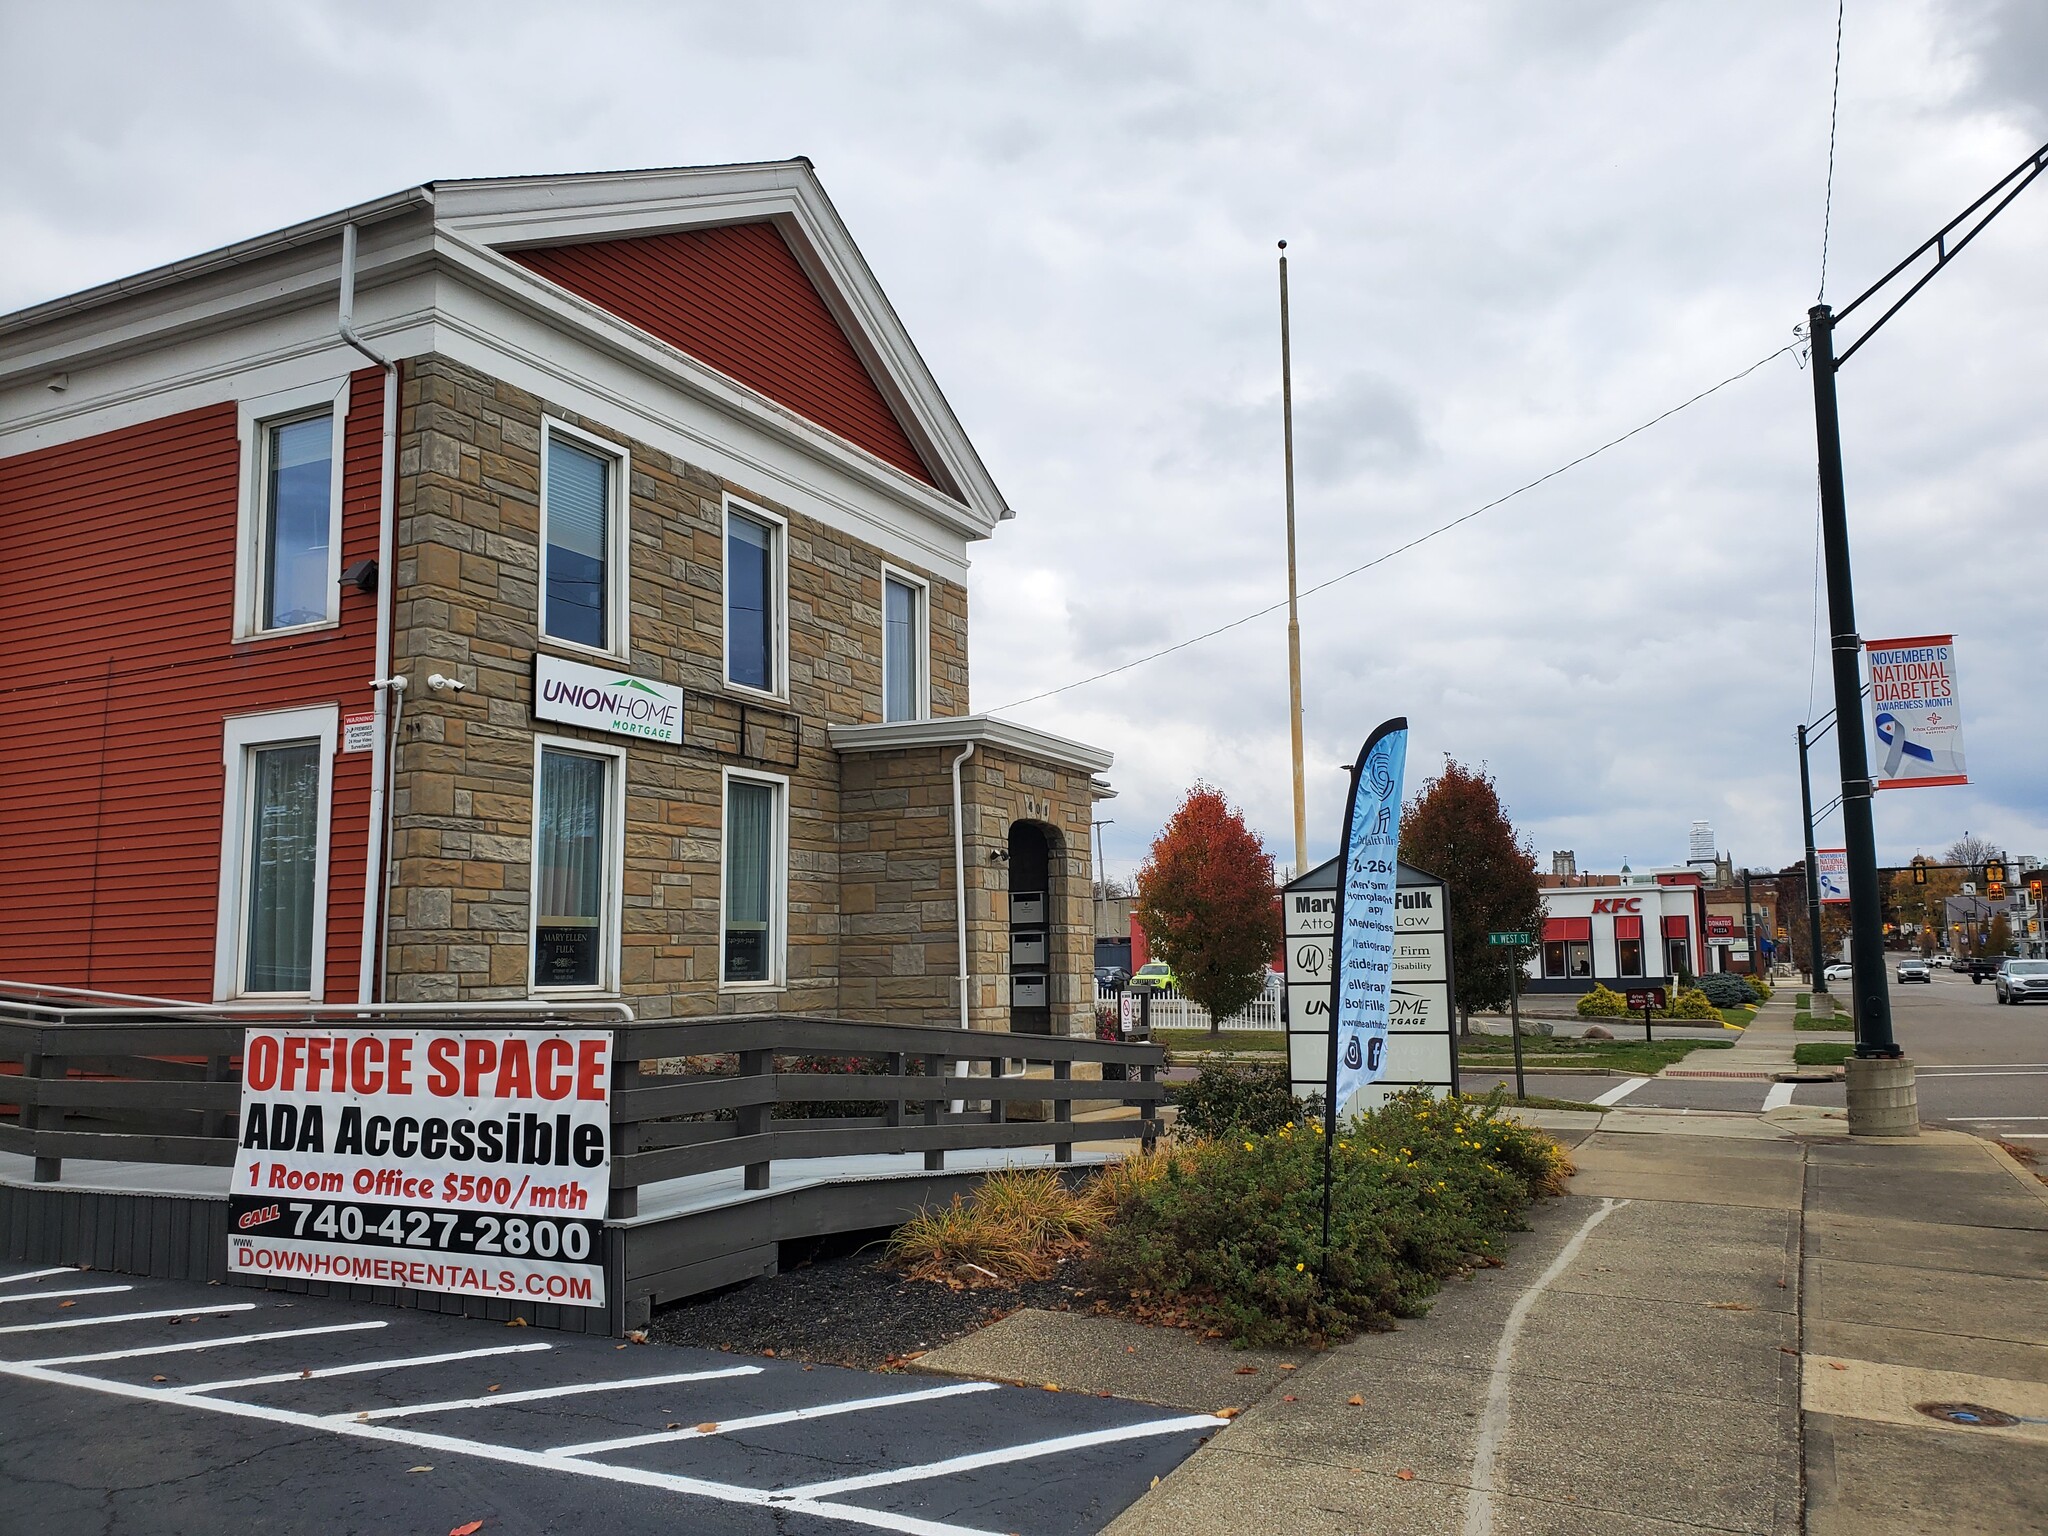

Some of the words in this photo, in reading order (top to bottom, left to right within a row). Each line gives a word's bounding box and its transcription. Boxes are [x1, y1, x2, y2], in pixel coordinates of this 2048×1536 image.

[1872, 649, 1934, 665] NOVEMBER
[1937, 647, 1948, 660] IS
[1872, 661, 1949, 683] NATIONAL
[1874, 679, 1951, 702] DIABETES
[1876, 699, 1924, 711] AWARENESS
[1925, 698, 1953, 708] MONTH
[345, 715, 374, 723] WARNING
[612, 720, 672, 739] MORTGAGE
[1028, 801, 1048, 817] 401
[1394, 891, 1432, 909] Fulk
[1591, 897, 1643, 914] KFC
[1300, 918, 1333, 929] Atto
[1396, 916, 1430, 926] Law
[1500, 935, 1517, 944] WEST
[1520, 934, 1529, 944] ST
[555, 945, 575, 953] FULK
[1401, 946, 1430, 955] Firm
[247, 1035, 413, 1095] OFFICE
[427, 1037, 607, 1101] SPACE
[243, 1103, 325, 1153] ADA
[334, 1106, 604, 1167] Accessible
[249, 1162, 260, 1187] 1
[268, 1165, 344, 1193] Room
[353, 1168, 434, 1199] Office
[442, 1172, 588, 1211] $500/mth
[238, 1204, 281, 1229] CALL
[289, 1203, 591, 1260] 740-427-2800
[238, 1247, 592, 1300] DOWNHOMERENTALS.COM
